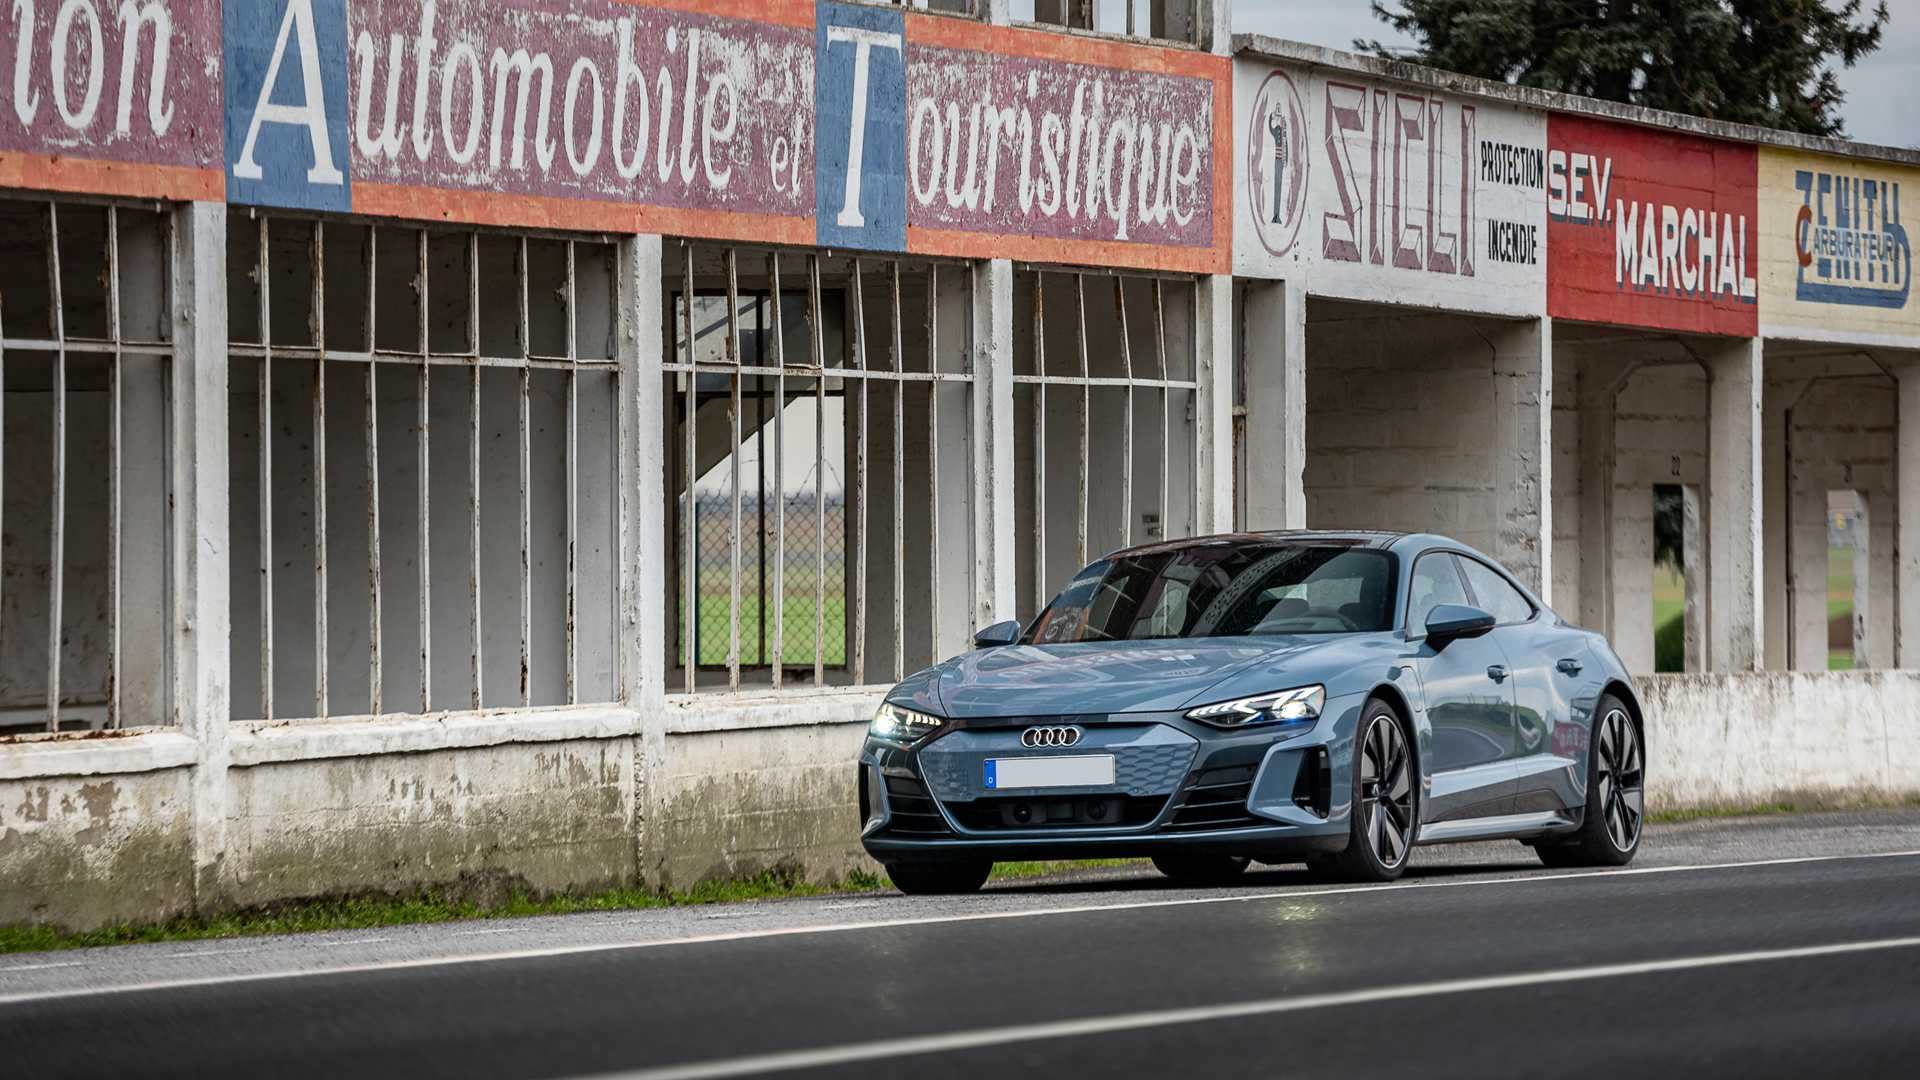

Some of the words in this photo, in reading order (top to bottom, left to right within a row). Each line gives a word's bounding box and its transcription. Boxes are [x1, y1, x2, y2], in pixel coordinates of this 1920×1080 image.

[233, 0, 739, 190] Automobile
[771, 109, 803, 197] et
[827, 26, 1201, 241] Touristique
[1323, 80, 1476, 276] SICLI
[1481, 140, 1544, 189] PROTECTION
[1488, 219, 1537, 265] INCENDIE
[1615, 198, 1756, 303] MARCHAL
[1796, 170, 1908, 302] ZENITH
